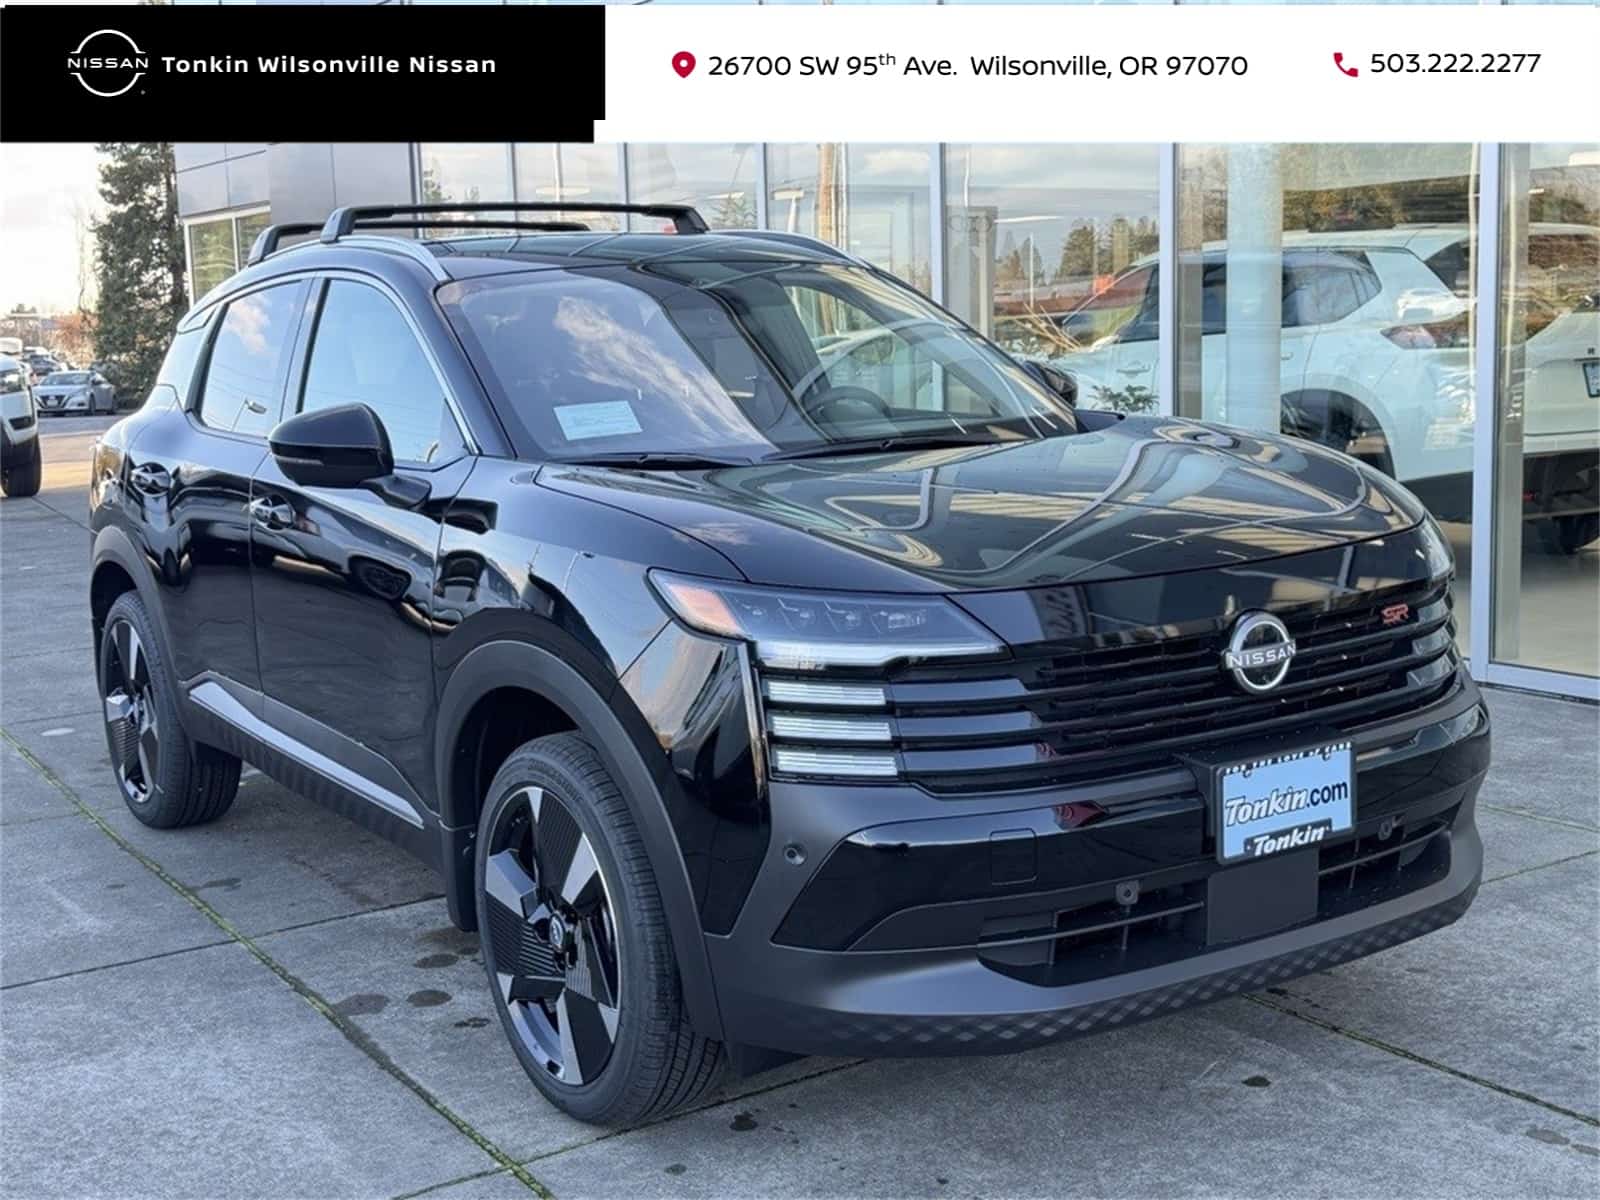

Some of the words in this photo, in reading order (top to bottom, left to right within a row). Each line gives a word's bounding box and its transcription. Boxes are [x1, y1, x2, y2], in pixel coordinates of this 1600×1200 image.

[1229, 642, 1297, 669] NISSAN
[1225, 780, 1349, 827] Tonkin.com
[1253, 825, 1325, 857] Tonkin
